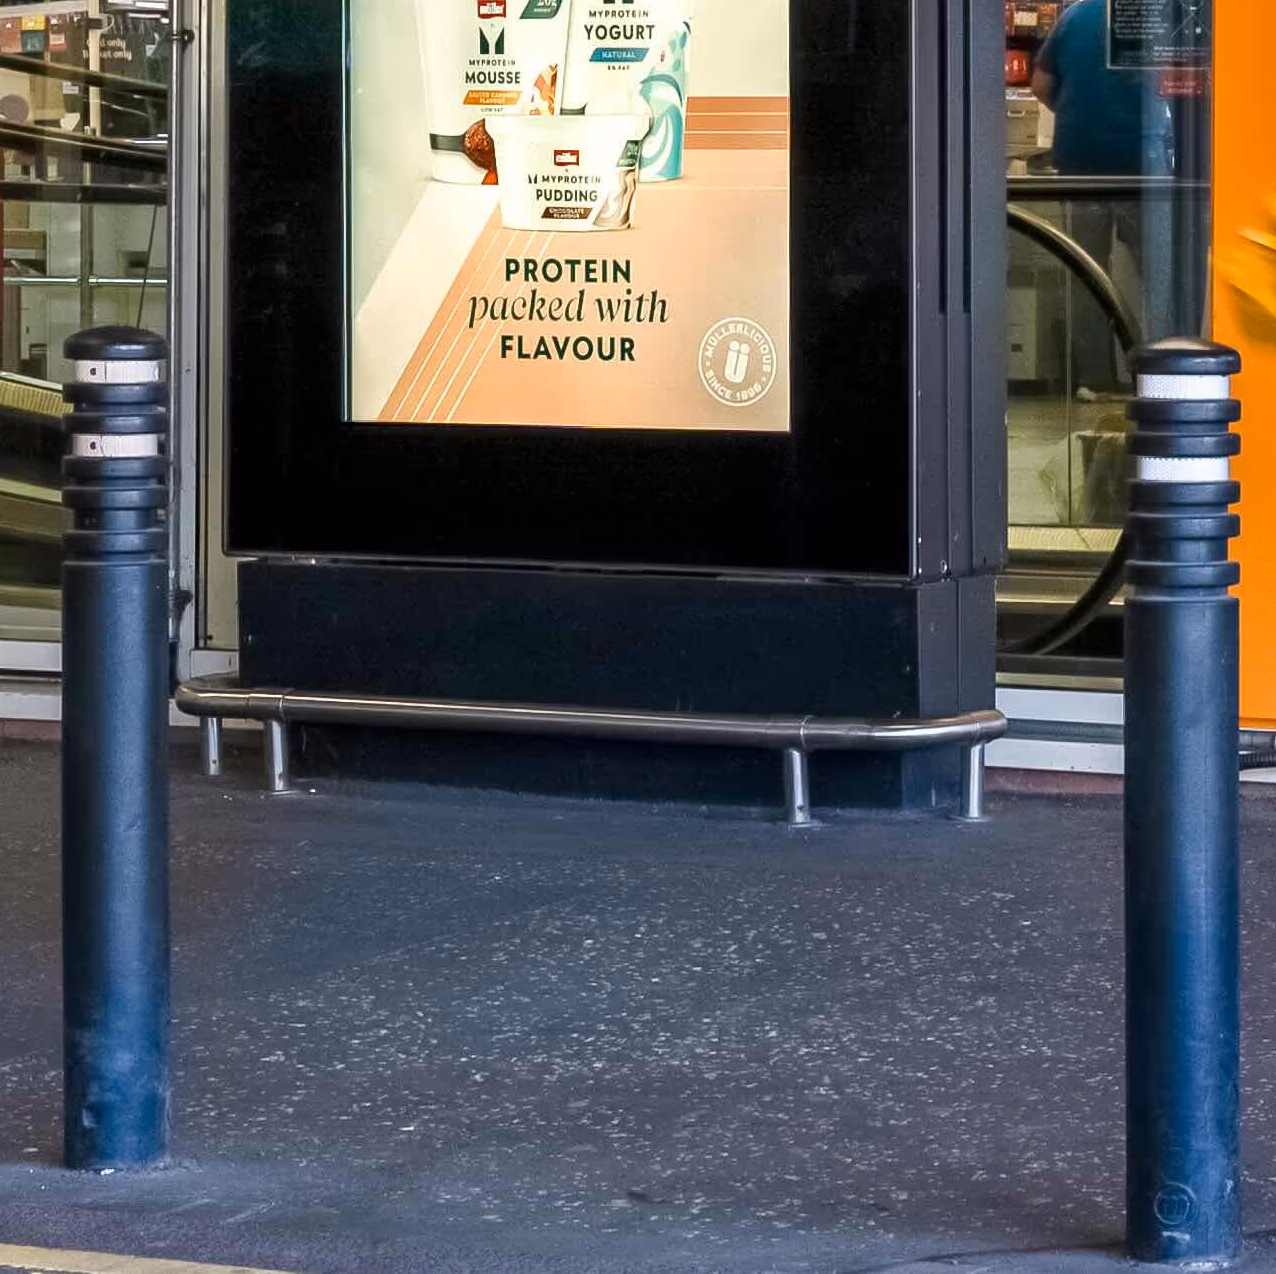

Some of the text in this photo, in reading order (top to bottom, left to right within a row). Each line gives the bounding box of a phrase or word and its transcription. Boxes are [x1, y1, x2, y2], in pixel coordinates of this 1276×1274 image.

[588, 9, 649, 19] MYPROTEIN
[584, 24, 656, 41] YOGURT
[468, 59, 516, 67] MYPROTEIN
[465, 71, 521, 85] MOUSSE
[541, 175, 601, 184] MYPROTEIN
[536, 188, 598, 202] PUDDING
[505, 258, 631, 283] PROTEIN
[468, 288, 669, 329] packed with
[501, 335, 636, 361] FLAVOUR
